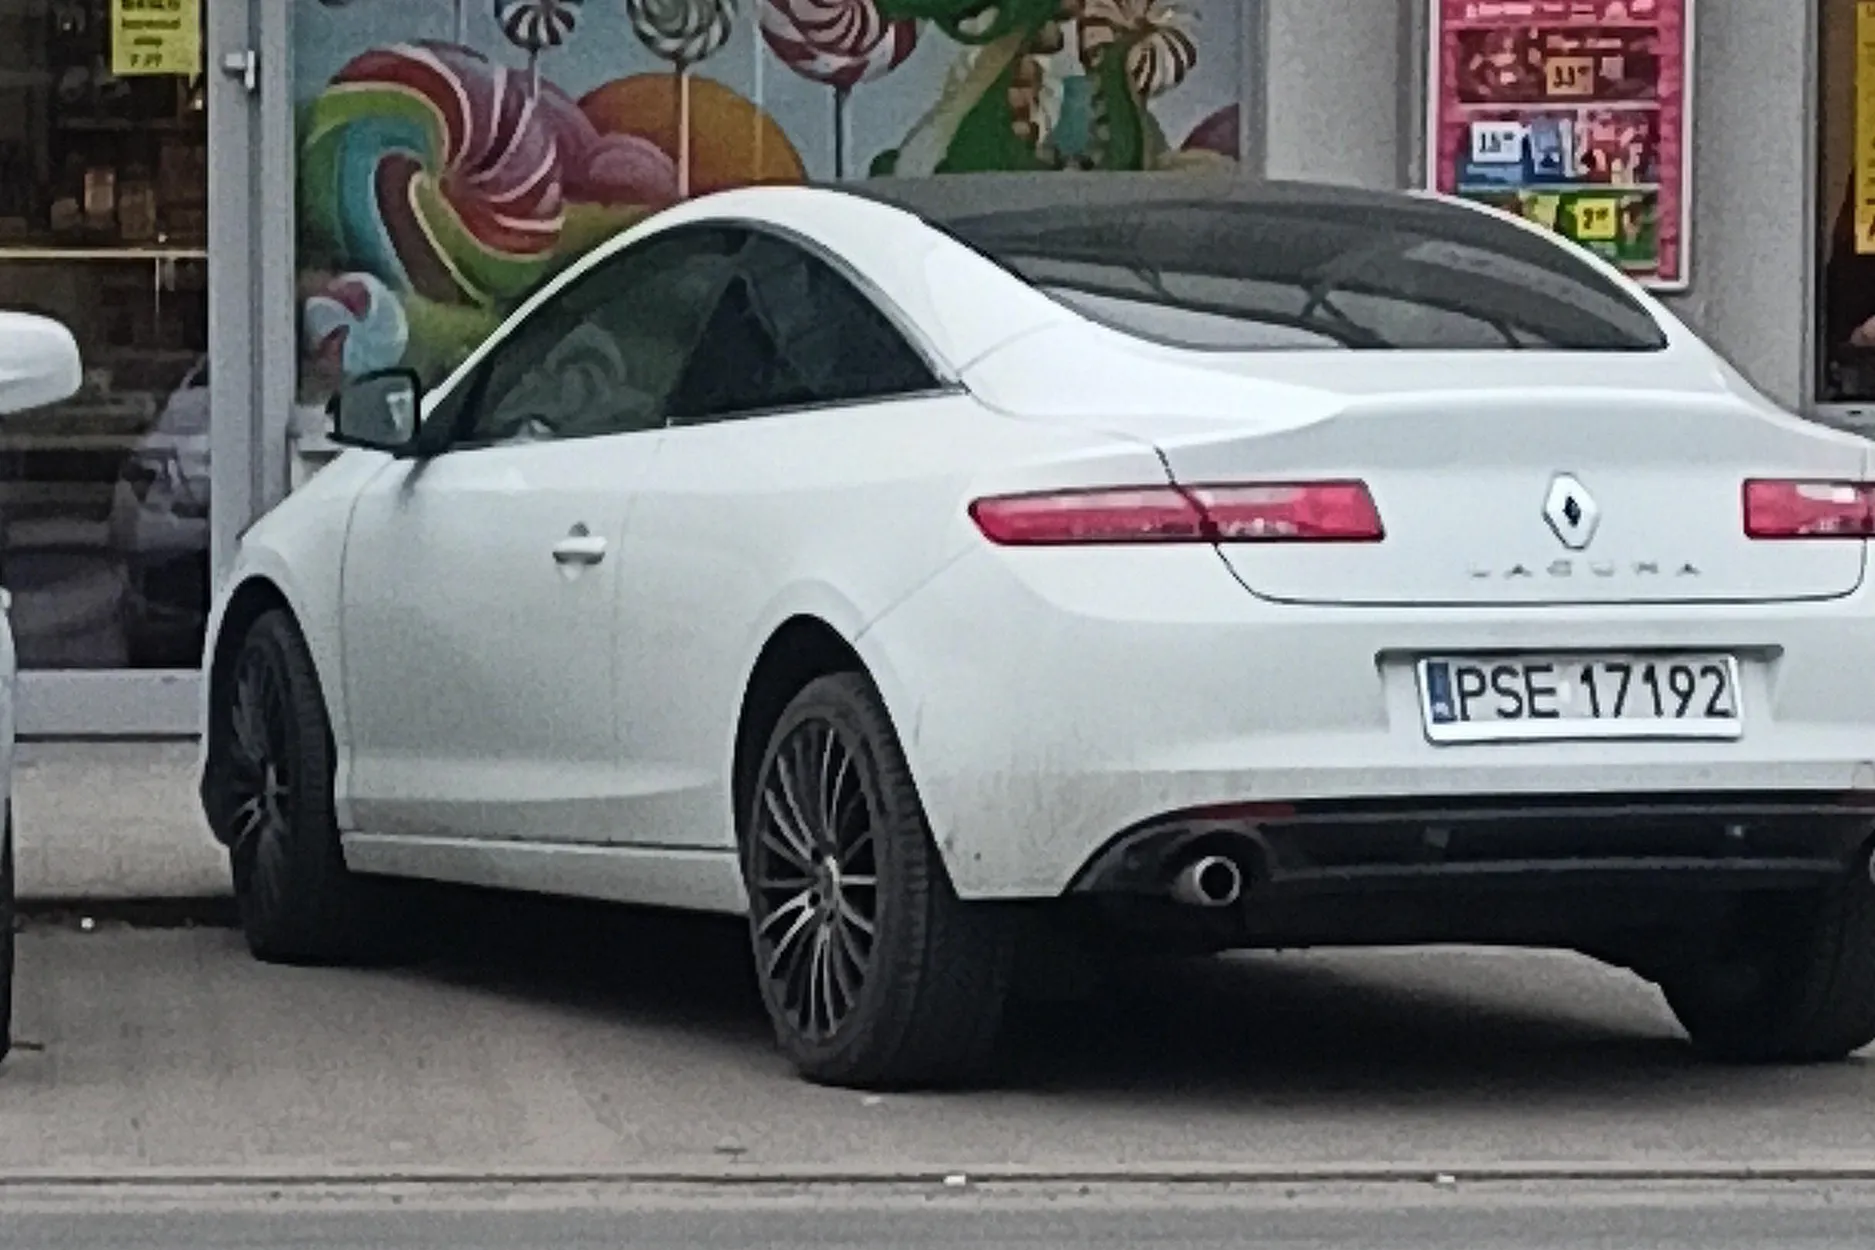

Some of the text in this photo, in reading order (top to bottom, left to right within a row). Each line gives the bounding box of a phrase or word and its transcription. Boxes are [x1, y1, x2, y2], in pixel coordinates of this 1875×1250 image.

[1468, 559, 1701, 579] LAGUNA
[1456, 662, 1732, 721] PSE 17192
